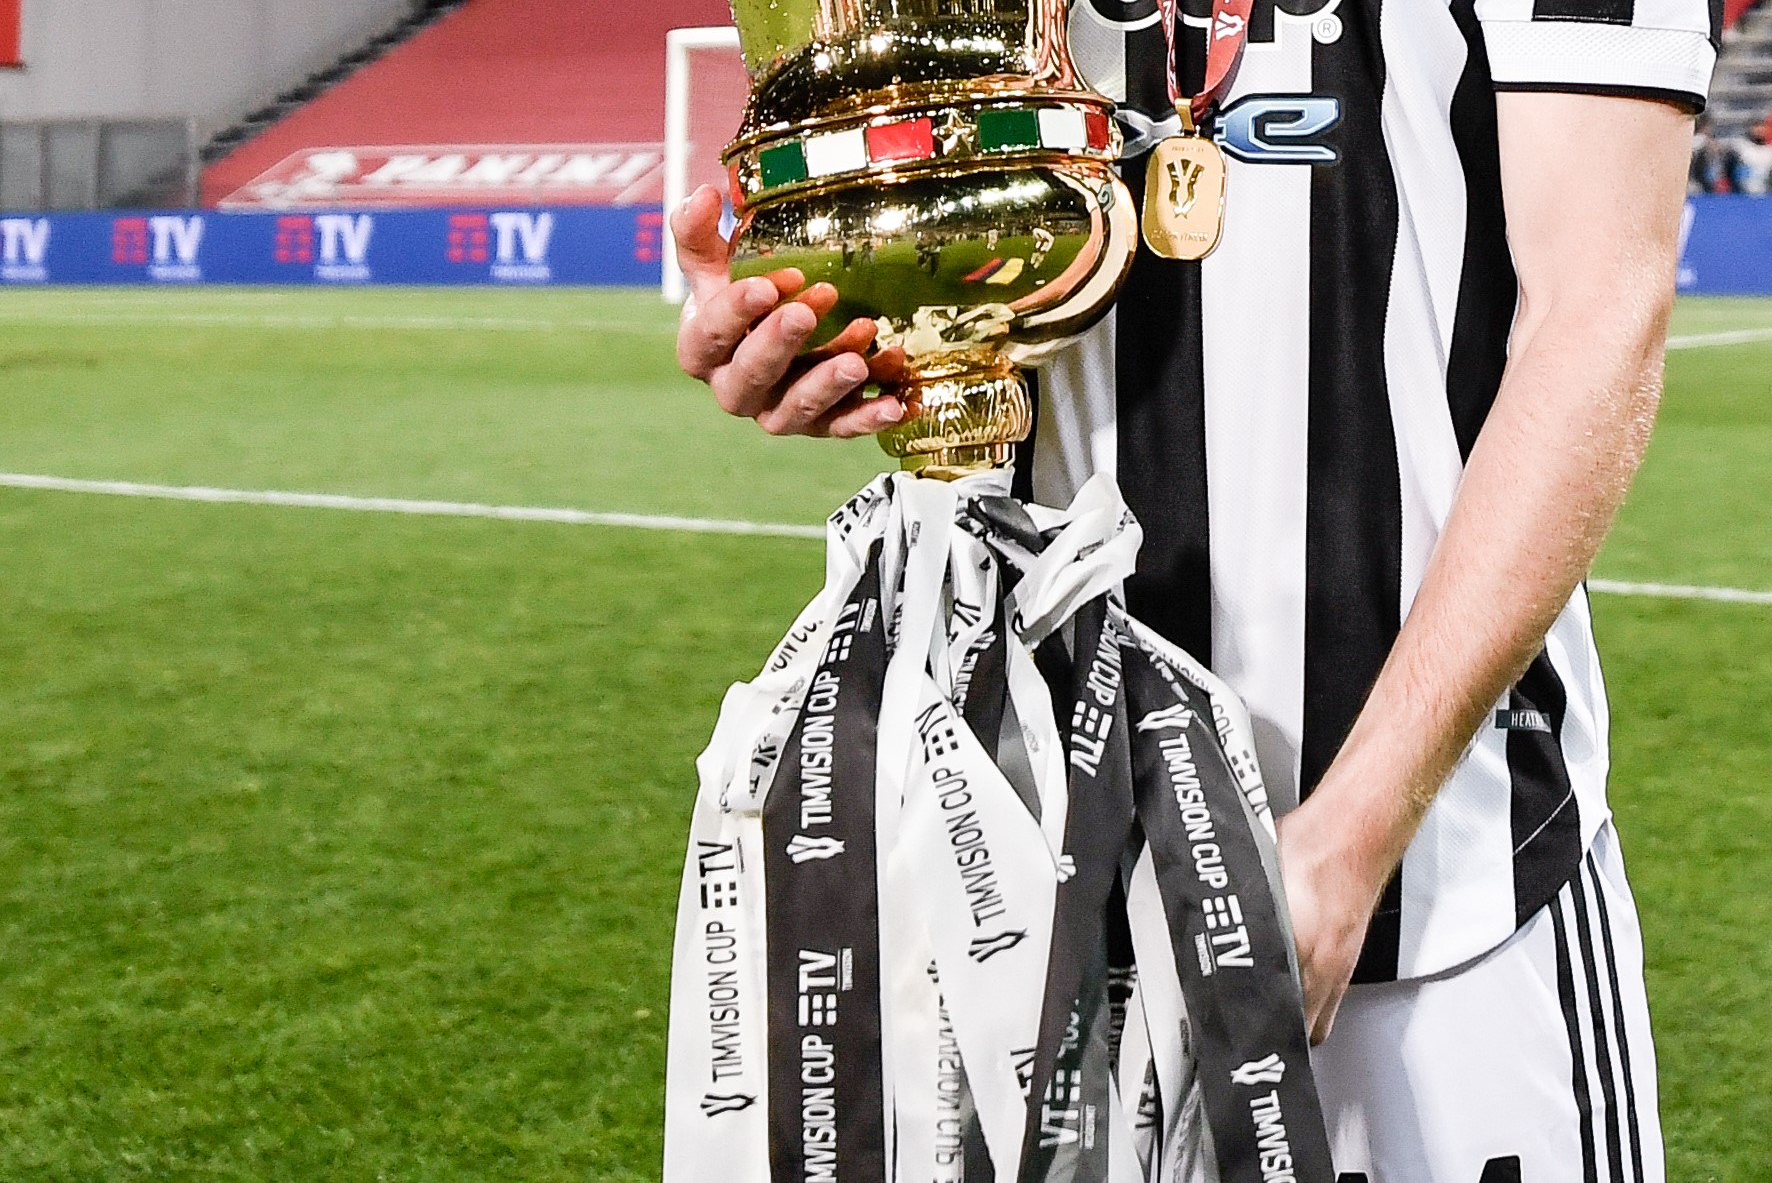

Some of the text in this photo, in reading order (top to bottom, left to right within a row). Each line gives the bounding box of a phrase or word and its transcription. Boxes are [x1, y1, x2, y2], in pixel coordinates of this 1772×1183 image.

[2, 218, 49, 264] TV
[149, 215, 204, 265] TV
[316, 214, 373, 265] TV
[490, 212, 553, 265] TV
[1086, 659, 1121, 707] CUP
[801, 670, 841, 830] TIMVISION CUP
[1070, 732, 1106, 779] TV
[697, 840, 735, 878] TV
[931, 767, 1007, 928] TIMVISION CUP
[1158, 732, 1217, 842] TIMVISION
[1191, 842, 1229, 891] CUP
[1211, 925, 1255, 968] TV
[797, 949, 837, 994] TV
[706, 920, 744, 1084] TIMVISION CUP
[801, 1033, 834, 1086] CUP
